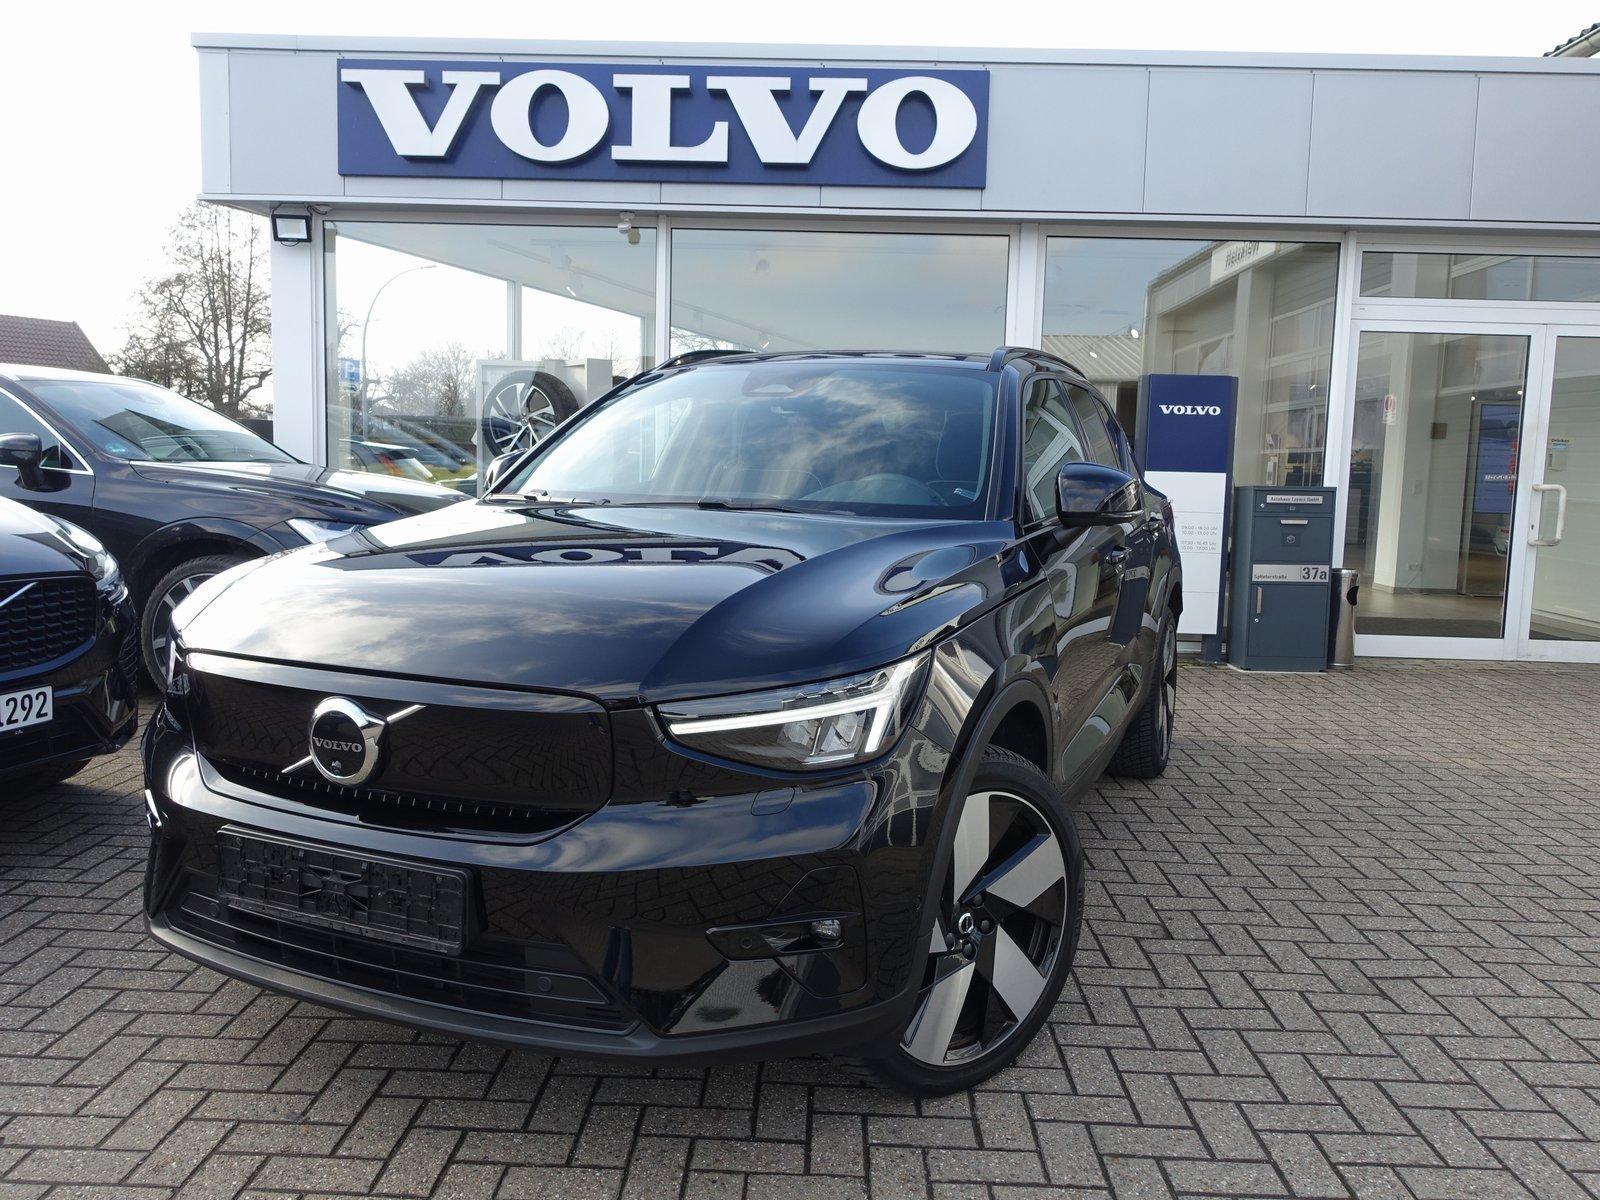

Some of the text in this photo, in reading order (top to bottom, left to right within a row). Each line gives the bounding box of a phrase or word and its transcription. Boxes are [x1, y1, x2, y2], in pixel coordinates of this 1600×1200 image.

[341, 69, 978, 170] VOLVO
[1158, 404, 1221, 416] VOLVO
[1302, 567, 1328, 580] 37a
[0, 691, 48, 728] 292
[312, 736, 363, 753] VOLVO
